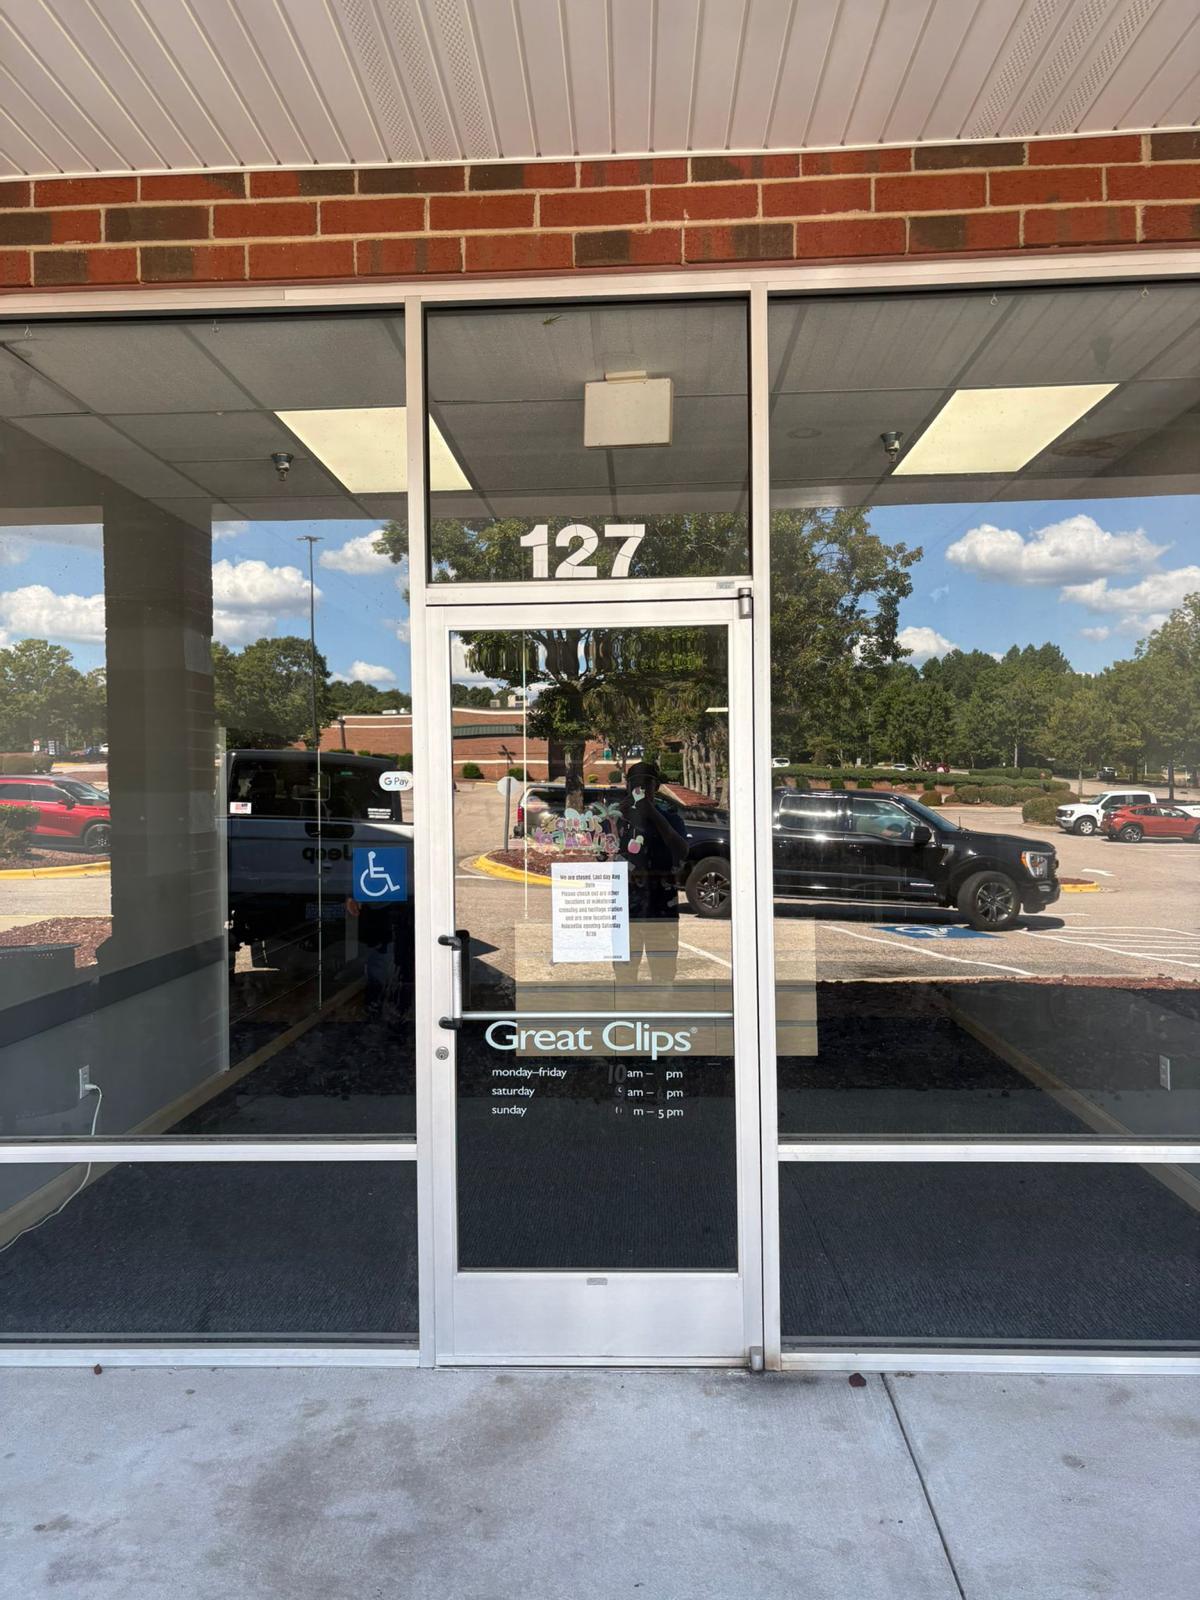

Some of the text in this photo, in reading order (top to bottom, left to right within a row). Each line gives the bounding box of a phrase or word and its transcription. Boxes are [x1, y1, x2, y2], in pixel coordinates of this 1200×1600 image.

[520, 524, 646, 578] 127
[394, 777, 409, 787] Pay
[485, 1020, 593, 1051] Great
[666, 1071, 683, 1081] pm
[492, 1086, 535, 1098] saturday
[627, 1089, 644, 1097] am
[666, 1090, 684, 1100] pm
[492, 1106, 527, 1117] sunday
[666, 1109, 684, 1119] pm
